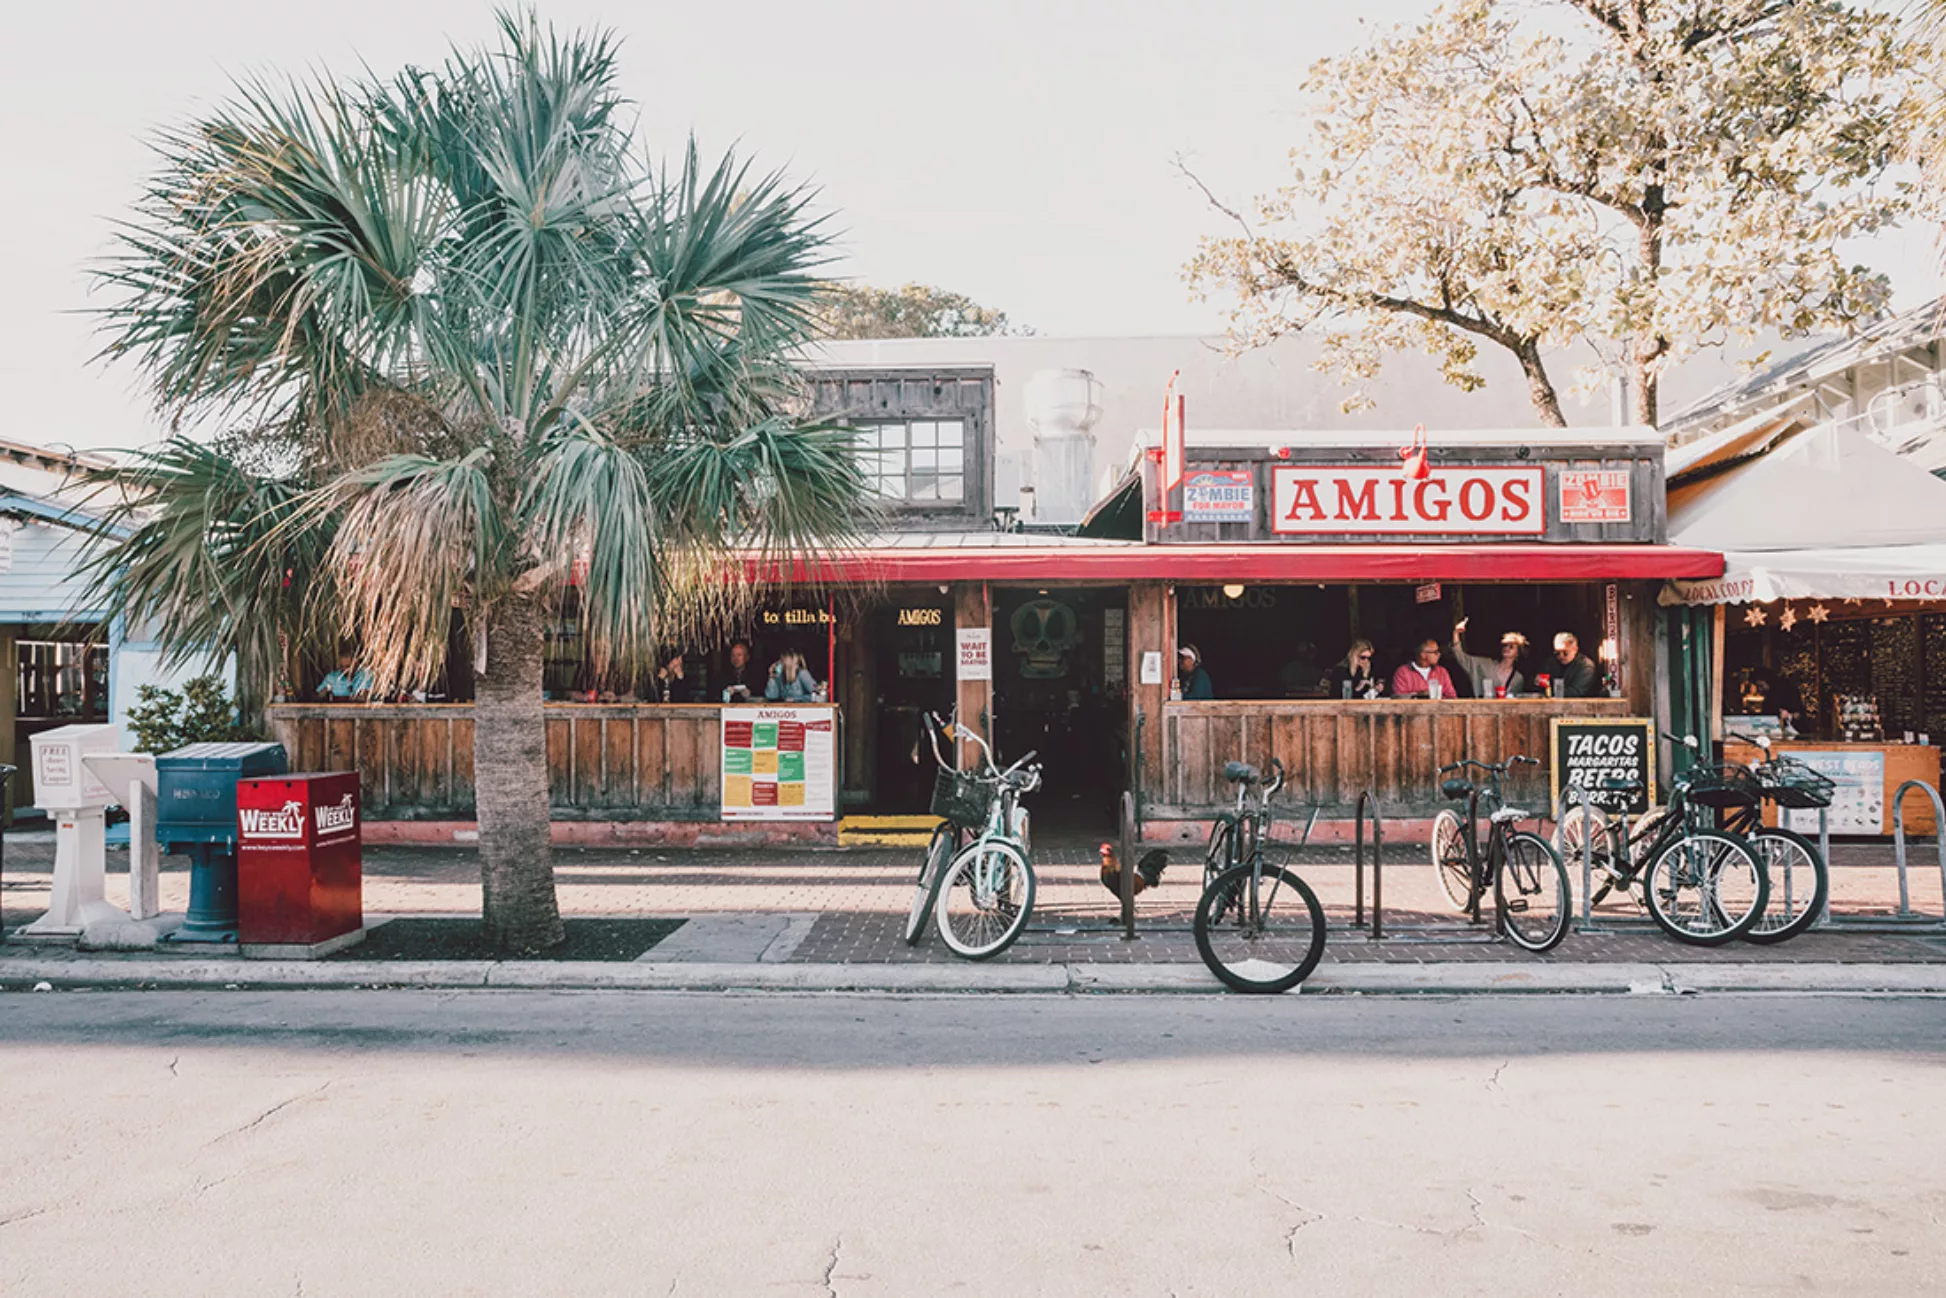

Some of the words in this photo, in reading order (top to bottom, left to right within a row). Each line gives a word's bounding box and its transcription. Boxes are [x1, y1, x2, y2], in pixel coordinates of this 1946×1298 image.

[1285, 478, 1530, 522] AMIGOS
[1684, 585, 1719, 600] LOCAL
[898, 609, 941, 626] AMIGOS
[960, 642, 987, 650] WAIT
[757, 710, 797, 719] AMIGOS
[1567, 734, 1639, 755] TACOS
[1567, 756, 1639, 767] MARGARITAS
[1568, 768, 1639, 788] BEERS
[1568, 790, 1638, 804] BRRTS
[240, 809, 305, 831] WEEKLY
[315, 805, 355, 829] WEEKLY
